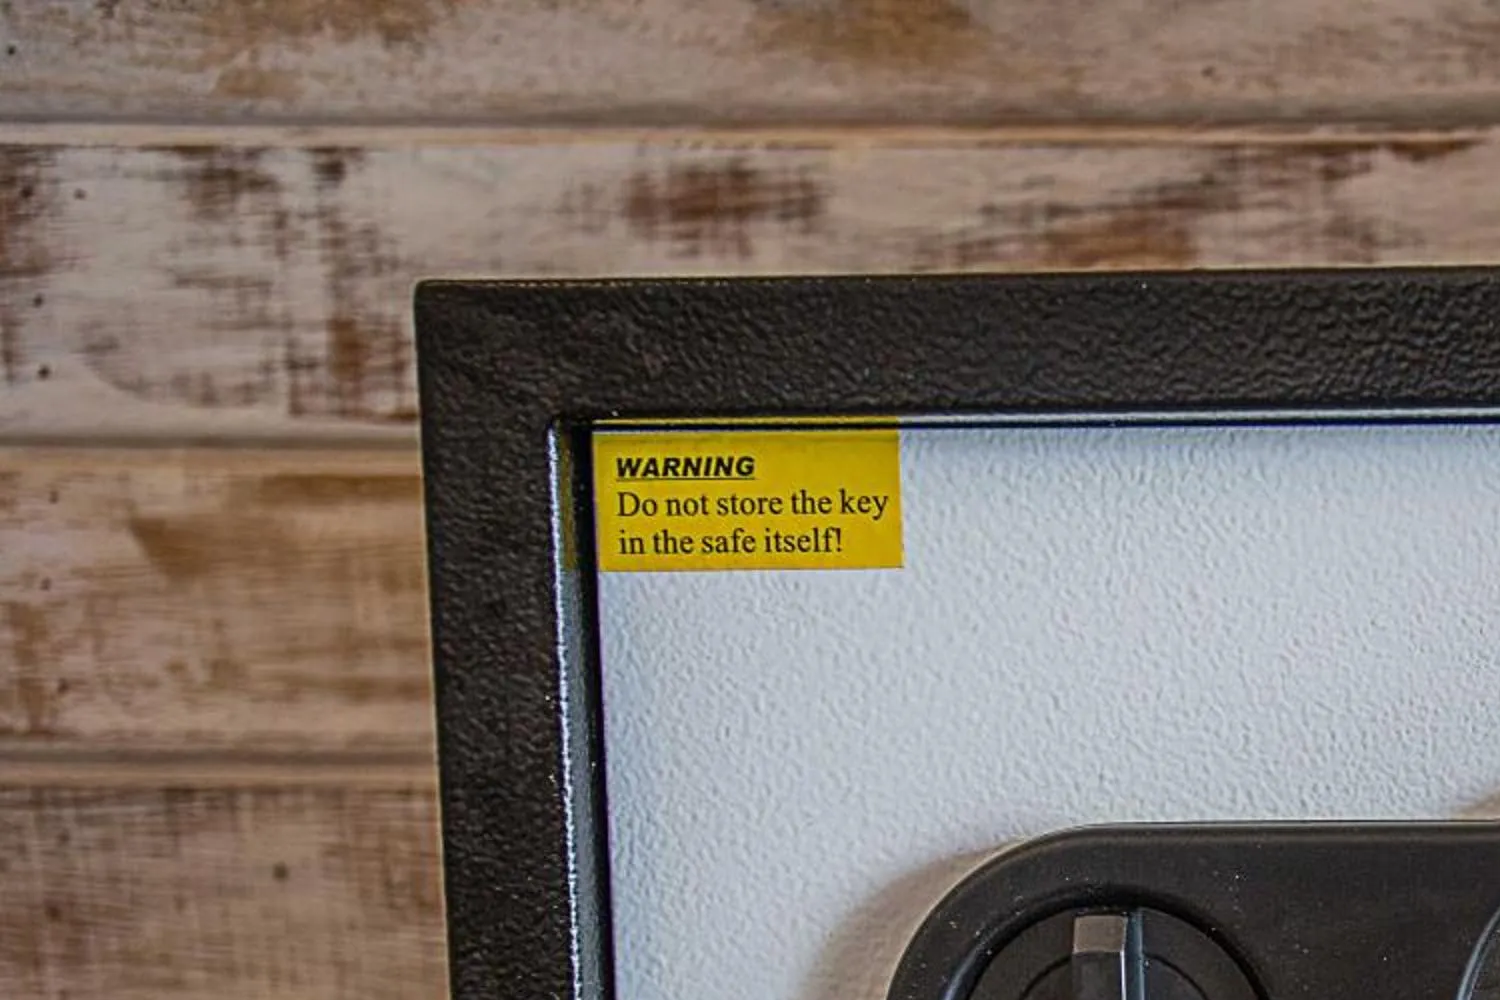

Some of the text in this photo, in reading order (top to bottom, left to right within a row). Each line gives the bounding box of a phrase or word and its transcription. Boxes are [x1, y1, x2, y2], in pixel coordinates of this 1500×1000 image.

[616, 456, 755, 480] WARNING
[617, 488, 889, 520] Do not store the key
[618, 527, 843, 554] in the safe itself!
